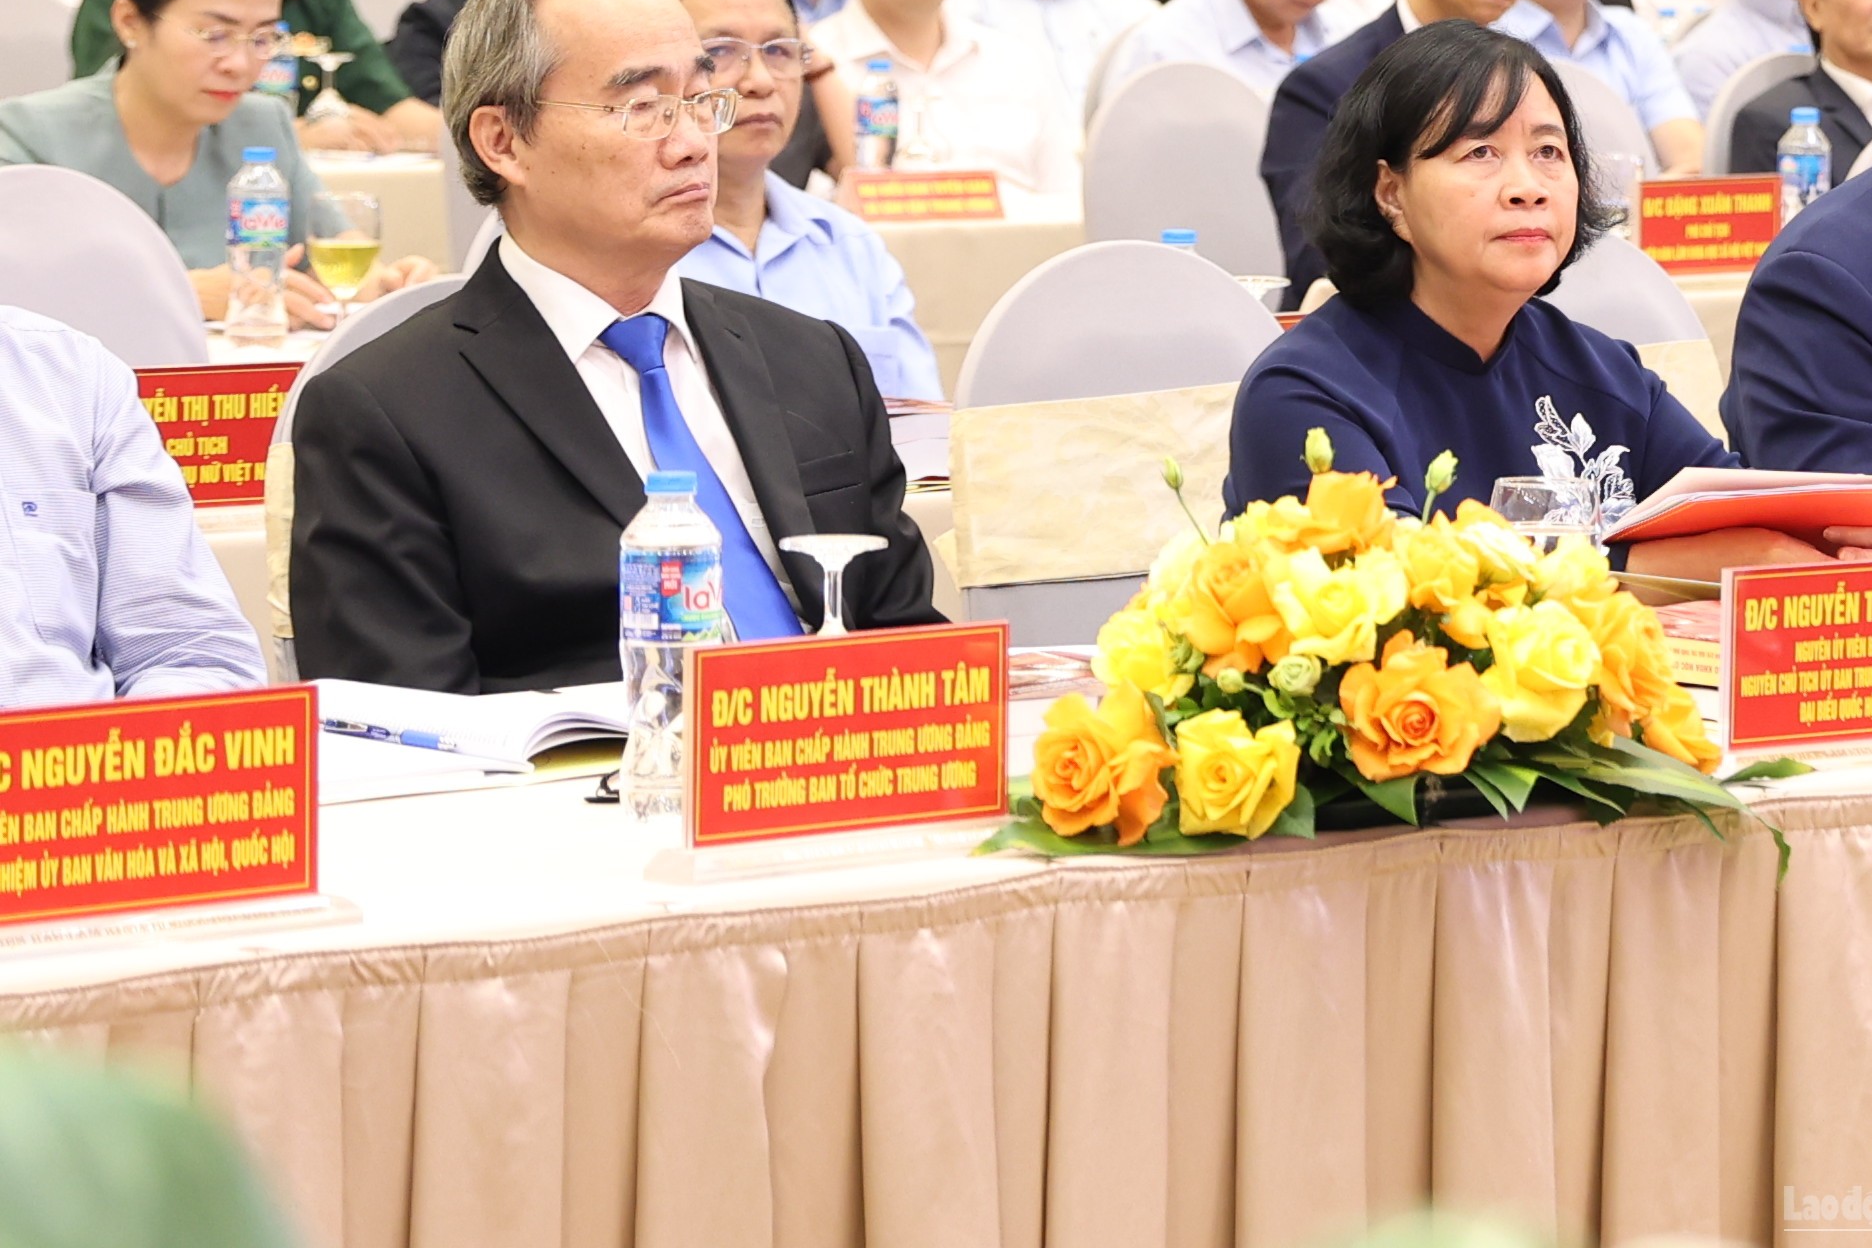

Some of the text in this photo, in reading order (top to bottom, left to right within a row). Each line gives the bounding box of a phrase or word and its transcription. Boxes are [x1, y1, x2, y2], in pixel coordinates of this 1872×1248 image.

[182, 394, 210, 426] THỊ
[213, 393, 246, 420] THU
[166, 432, 229, 459] CHỦ TỊCH
[222, 459, 254, 486] VIỆT
[1744, 596, 1779, 632] Đ/C
[1783, 580, 1861, 630] NGUYỄN
[711, 659, 991, 729] Đ/C NGUYỄN THÀNH TÂM
[1833, 667, 1852, 691] BAN
[20, 726, 147, 791] NGUYỄN
[153, 719, 216, 778] ĐẮC
[222, 725, 296, 771] VINH
[709, 713, 991, 774] ỦY VIÊN BAN CHẤP HÀNH TRUNG ƯƠNG ĐẢNG
[23, 810, 58, 844] BAN
[60, 796, 103, 840] CHẤP
[106, 797, 149, 835] HÀNH
[152, 796, 204, 831] TRUNG
[206, 790, 250, 825] ƯƠNG
[252, 779, 296, 820] ĐẢNG
[722, 777, 752, 813] PHÓ
[809, 772, 838, 804] BAN
[839, 761, 857, 801] TỔ
[858, 763, 895, 800] CHỨC
[896, 762, 940, 795] TRUNG
[940, 759, 978, 791] ƯƠNG
[39, 849, 60, 889] ỦY
[61, 854, 93, 888] BAN
[94, 847, 124, 883] VĂN
[126, 843, 155, 880] HÓA
[157, 839, 178, 877] VÀ
[178, 836, 200, 875] XÃ
[231, 827, 269, 872] QUỐC
[271, 827, 296, 870] HỘI
